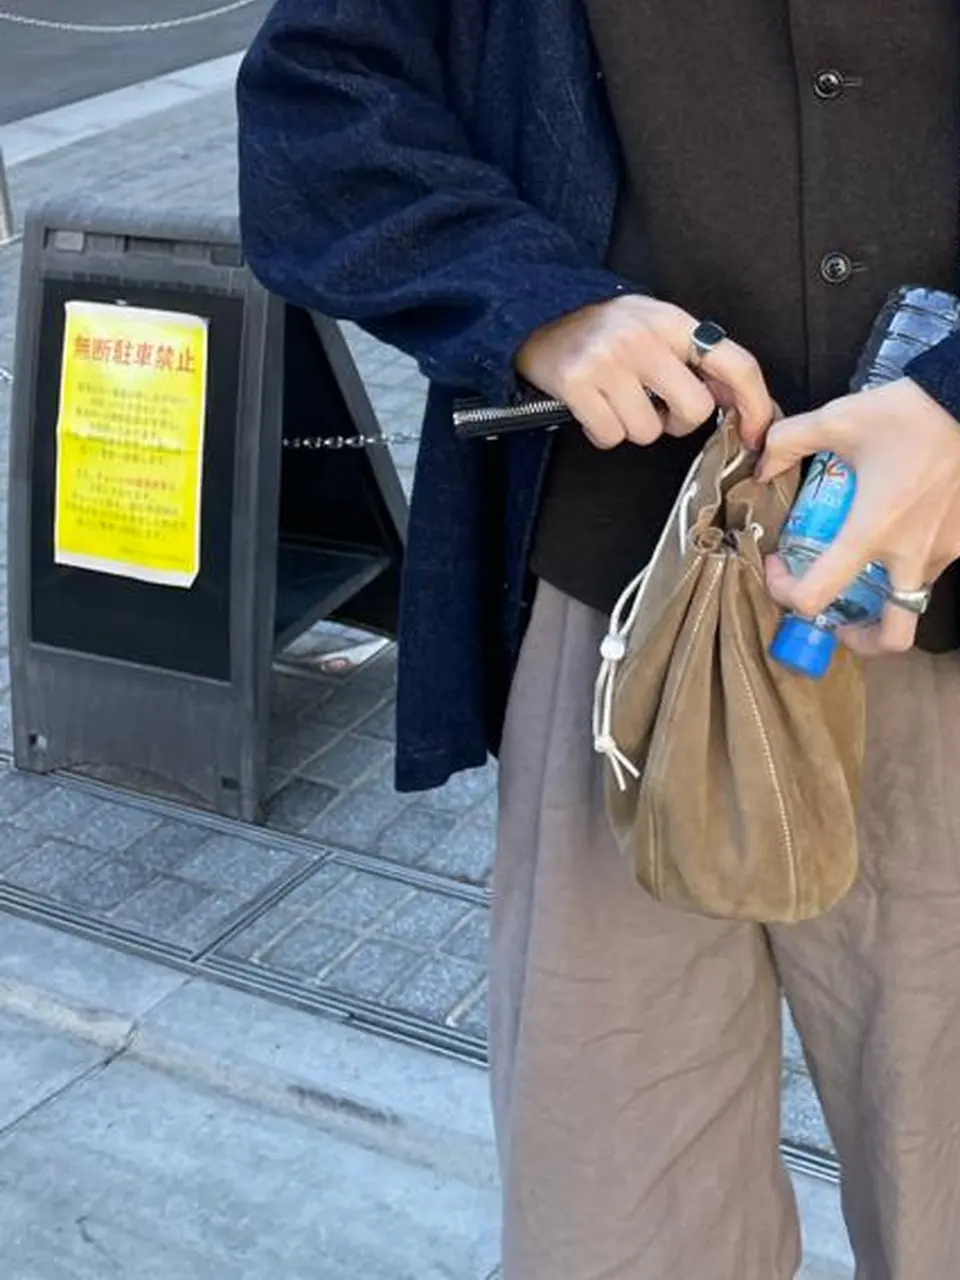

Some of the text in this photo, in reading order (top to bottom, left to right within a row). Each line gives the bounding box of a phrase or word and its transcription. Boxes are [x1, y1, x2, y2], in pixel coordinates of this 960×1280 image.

[73, 333, 196, 373] 無断駐車禁止
